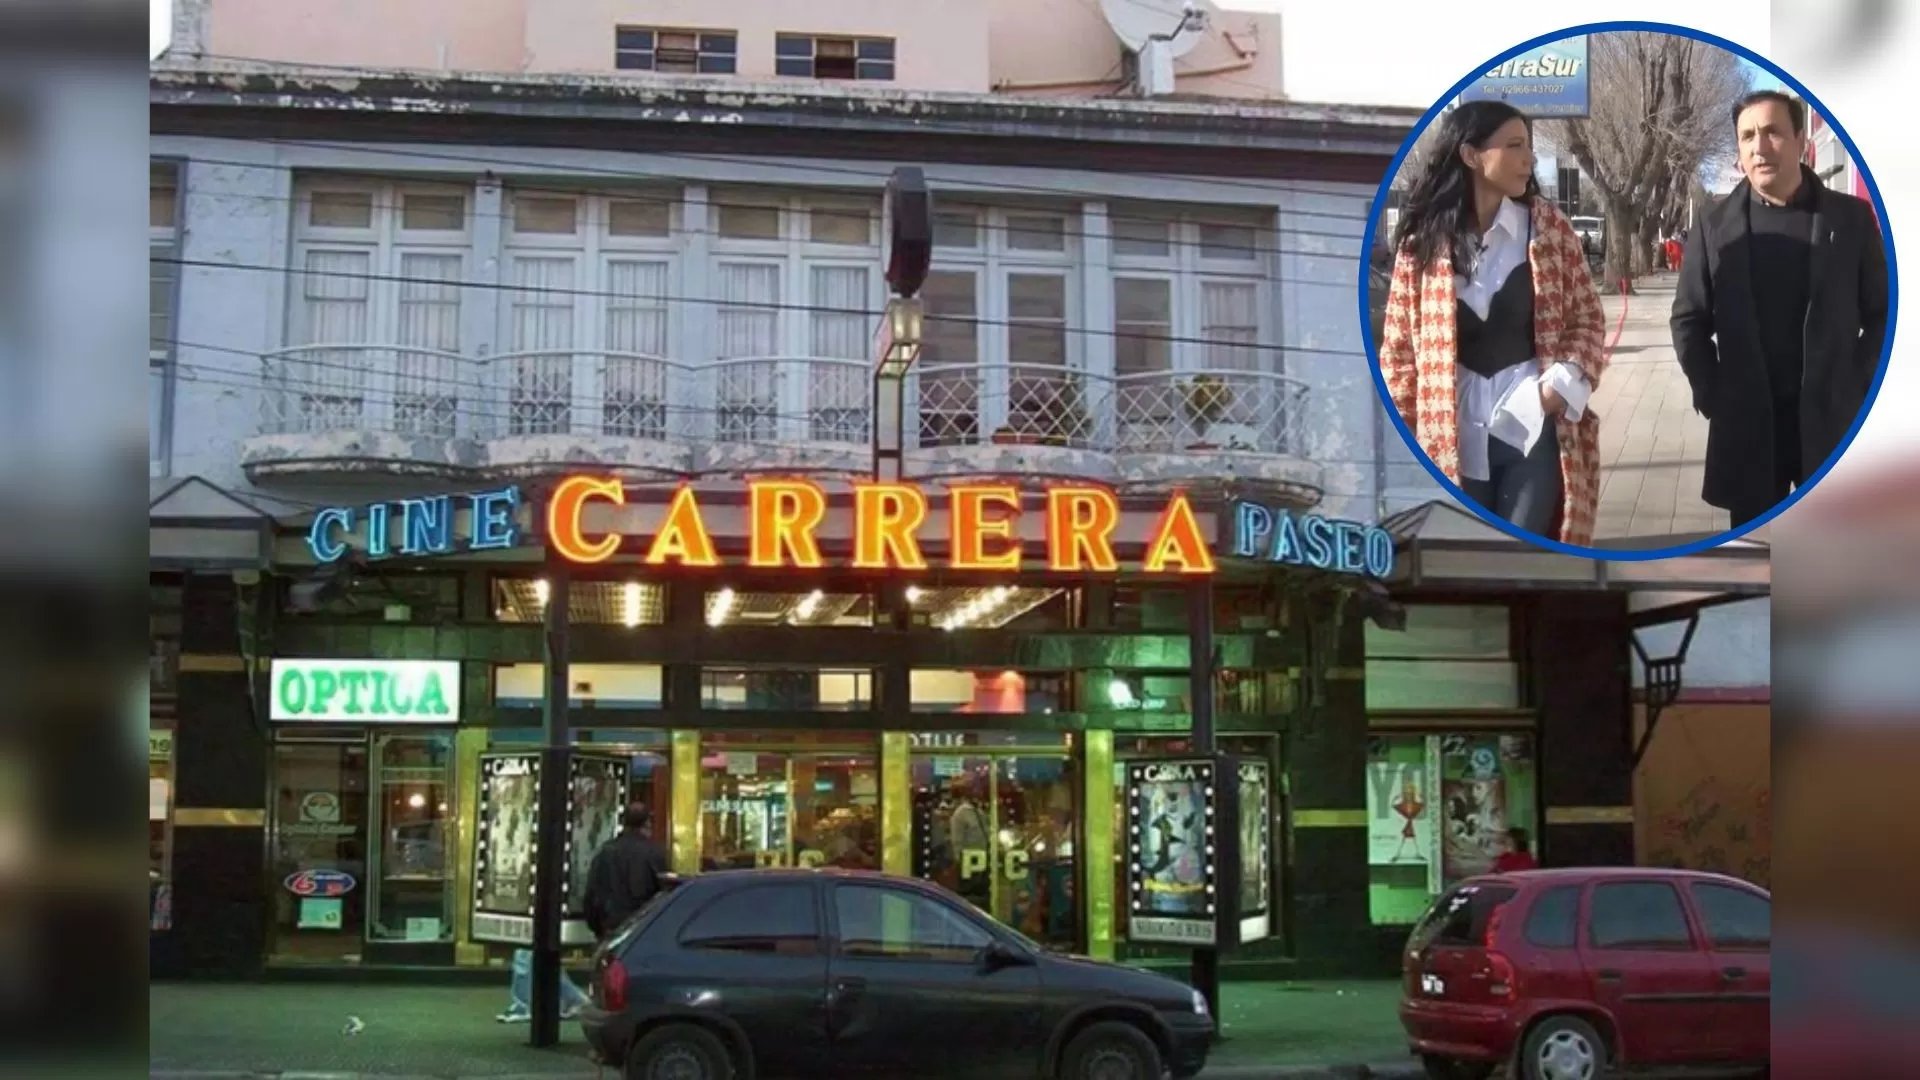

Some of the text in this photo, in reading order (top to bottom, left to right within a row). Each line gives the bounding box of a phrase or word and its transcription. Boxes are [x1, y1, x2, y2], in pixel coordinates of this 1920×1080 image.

[305, 475, 1396, 580] CINE CARRERA PASEO
[279, 668, 450, 715] OPTICA
